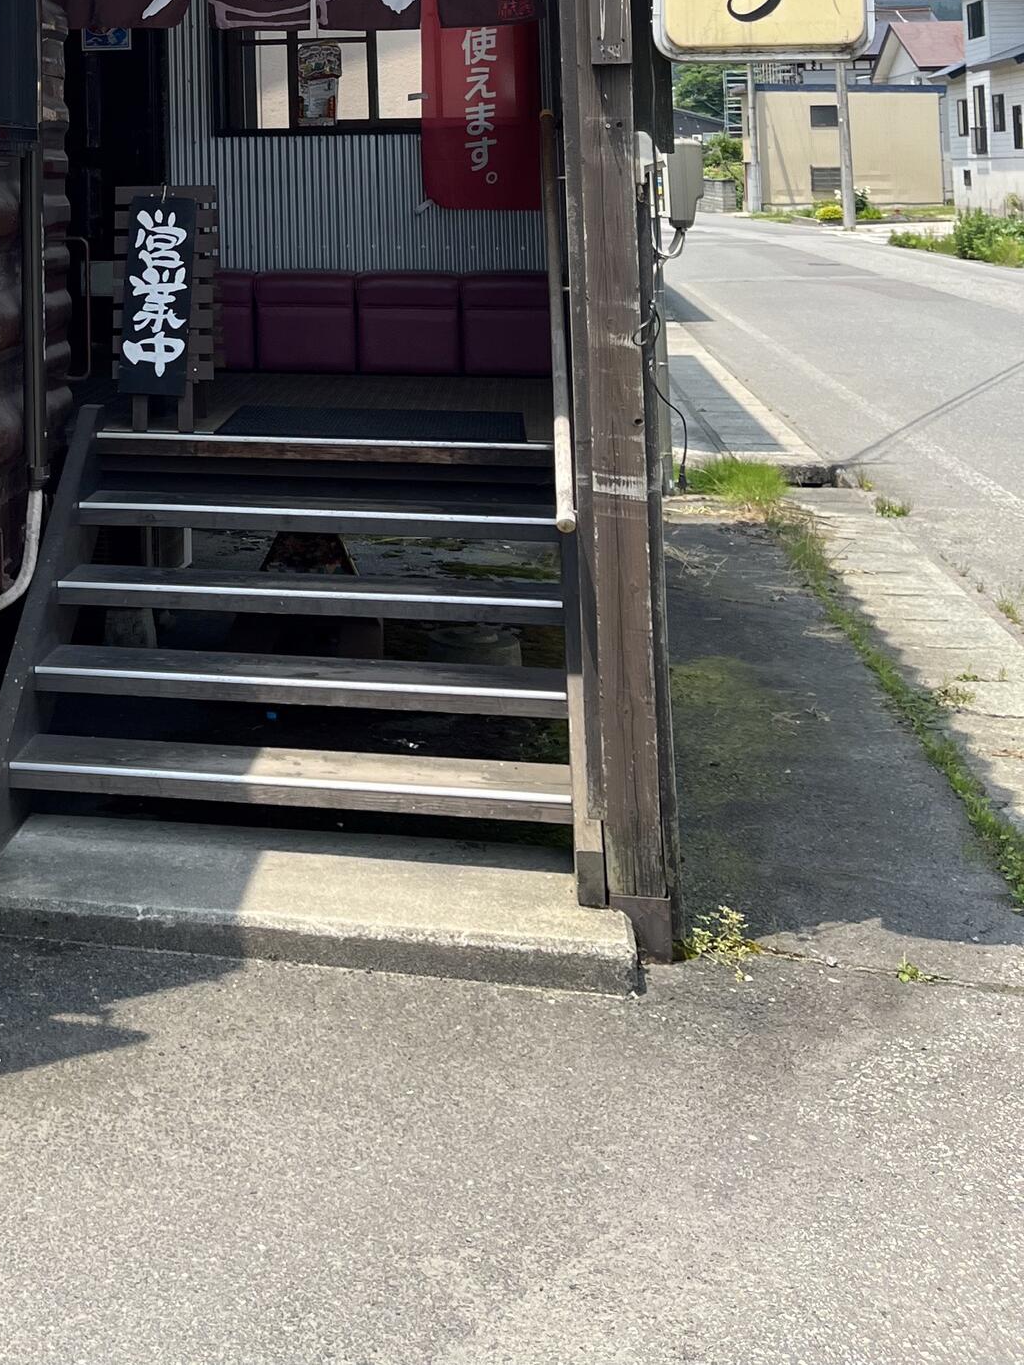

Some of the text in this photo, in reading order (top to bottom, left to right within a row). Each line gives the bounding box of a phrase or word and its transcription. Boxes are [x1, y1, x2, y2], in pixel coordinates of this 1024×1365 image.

[461, 26, 499, 185] 使えます。
[122, 208, 188, 378] 営業中
